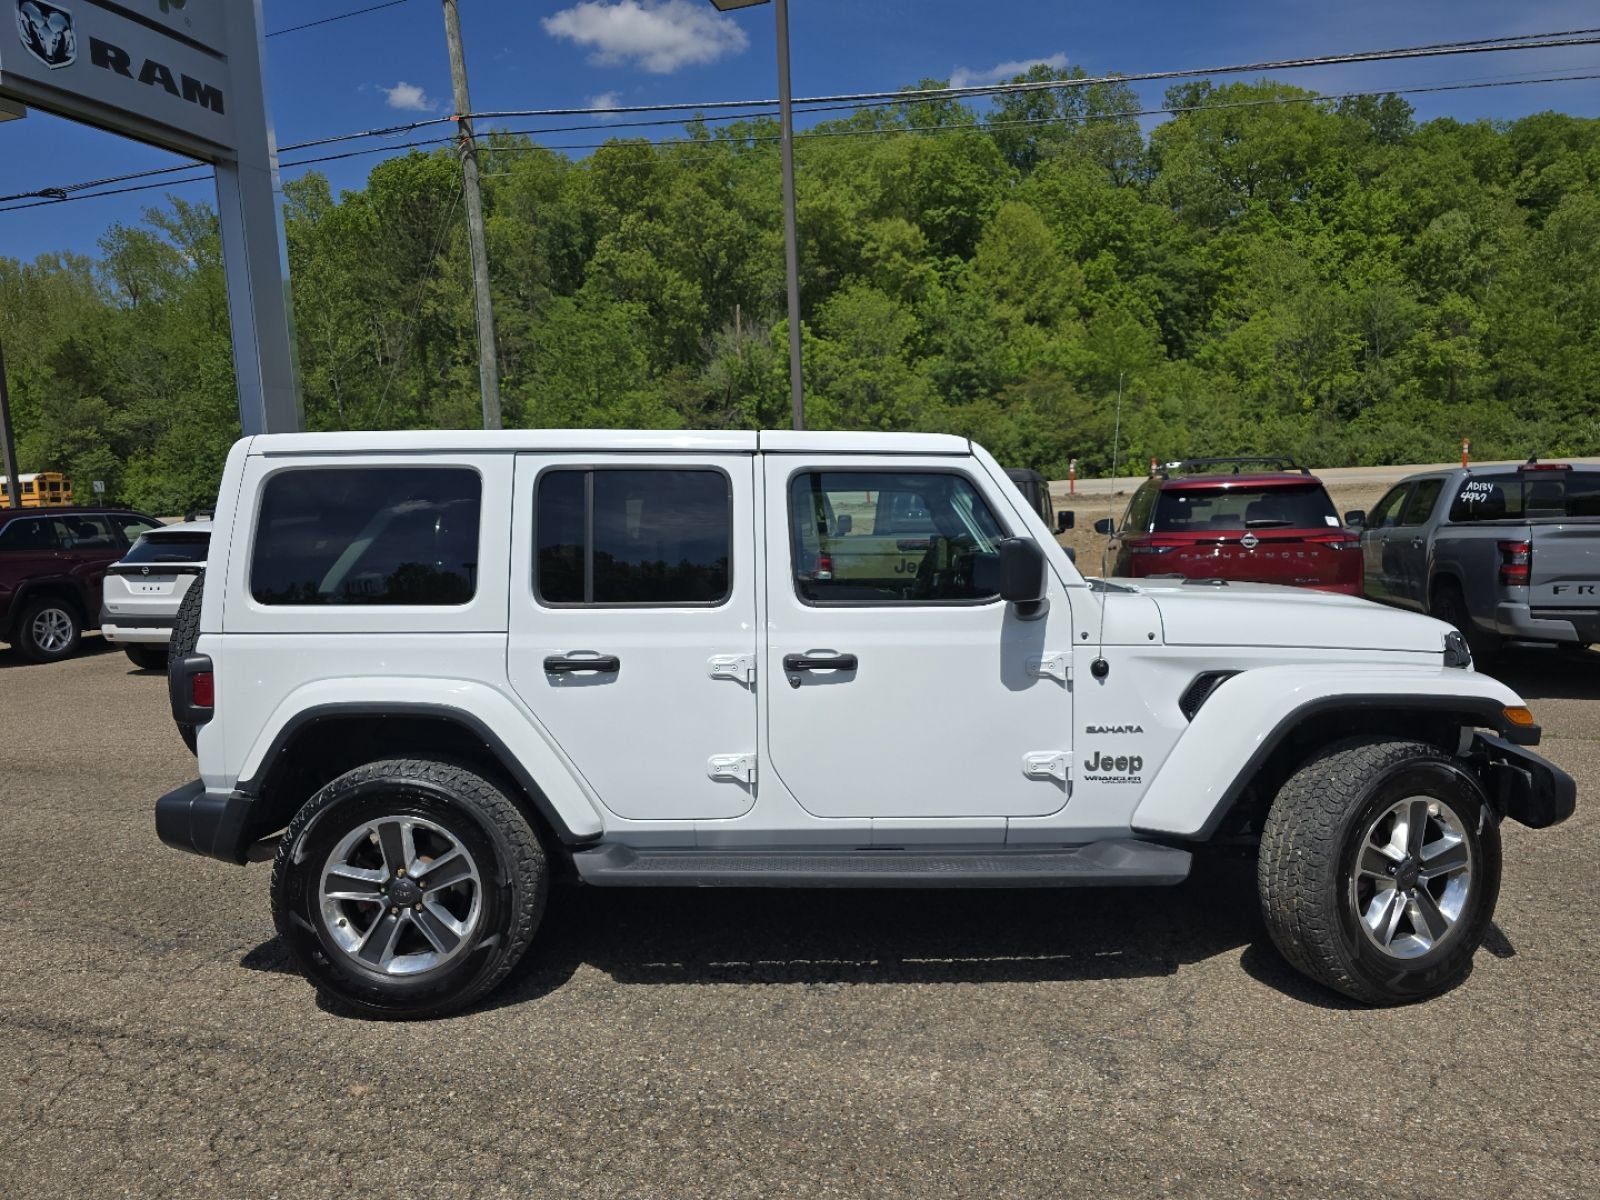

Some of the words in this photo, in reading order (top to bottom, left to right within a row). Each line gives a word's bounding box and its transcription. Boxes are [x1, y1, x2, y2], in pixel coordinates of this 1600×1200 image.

[89, 36, 225, 115] RAM
[895, 558, 917, 574] Je
[1085, 725, 1144, 734] SAHARA
[1084, 751, 1143, 775] Jeep
